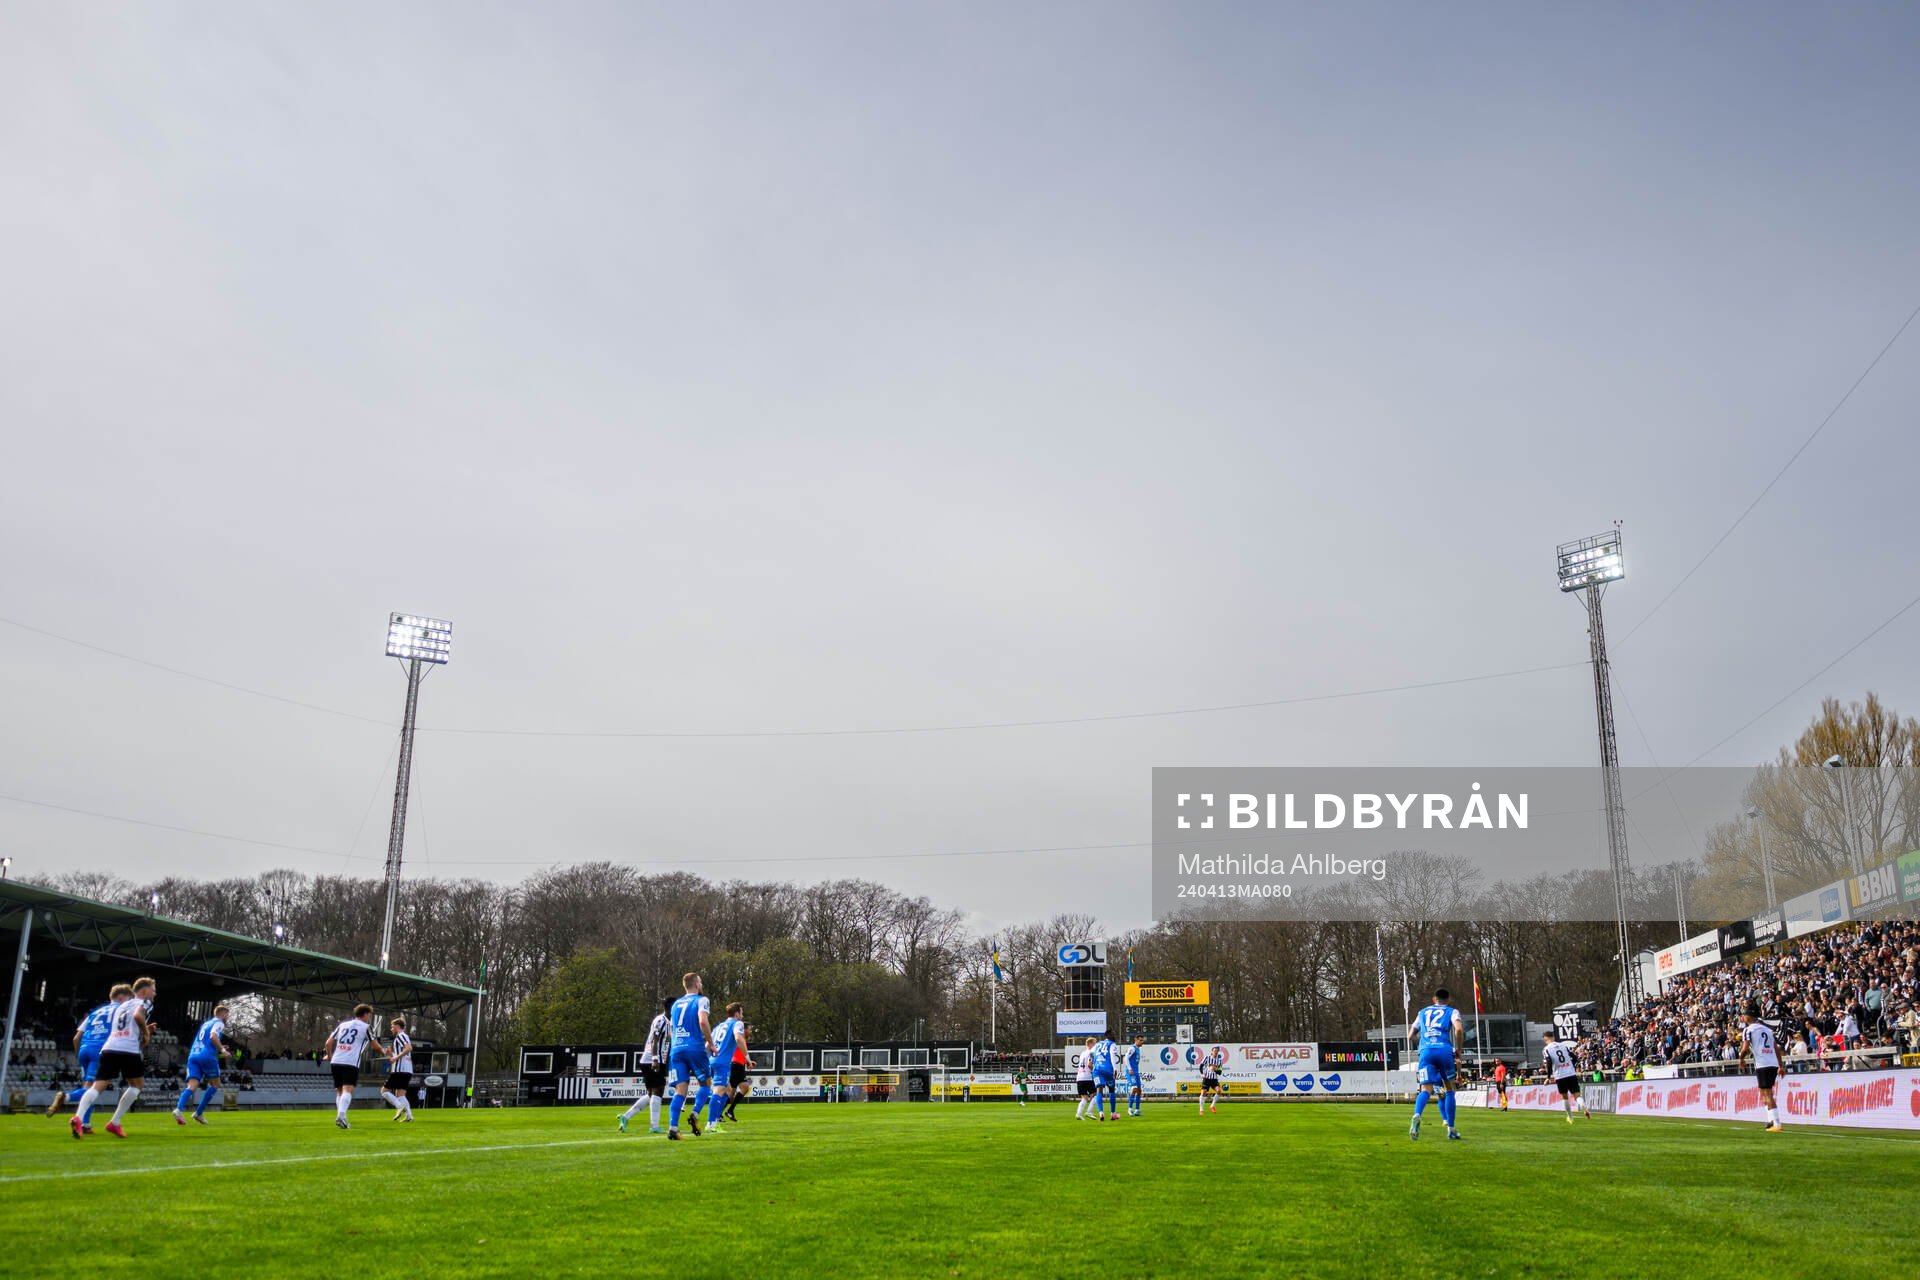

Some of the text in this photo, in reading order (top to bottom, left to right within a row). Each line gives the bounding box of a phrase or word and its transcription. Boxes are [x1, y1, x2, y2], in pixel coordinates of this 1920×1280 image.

[1859, 864, 1896, 904] BBM
[1058, 944, 1105, 963] GDL
[1140, 987, 1185, 999] OHLSSONS
[117, 1010, 129, 1031] 9
[676, 1002, 689, 1026] 7
[1424, 1009, 1445, 1028] 12
[338, 1028, 359, 1045] 23
[1558, 1026, 1579, 1039] LY!
[1761, 1032, 1770, 1048] 2
[1096, 1043, 1109, 1056] 24
[1239, 1045, 1313, 1060] TEAMAB
[1324, 1051, 1391, 1062] HEMMAKVÄLL
[1556, 1050, 1565, 1063] 8
[1033, 1084, 1072, 1092] EKEBY MÖBLER
[1786, 1090, 1818, 1116] OATLY!
